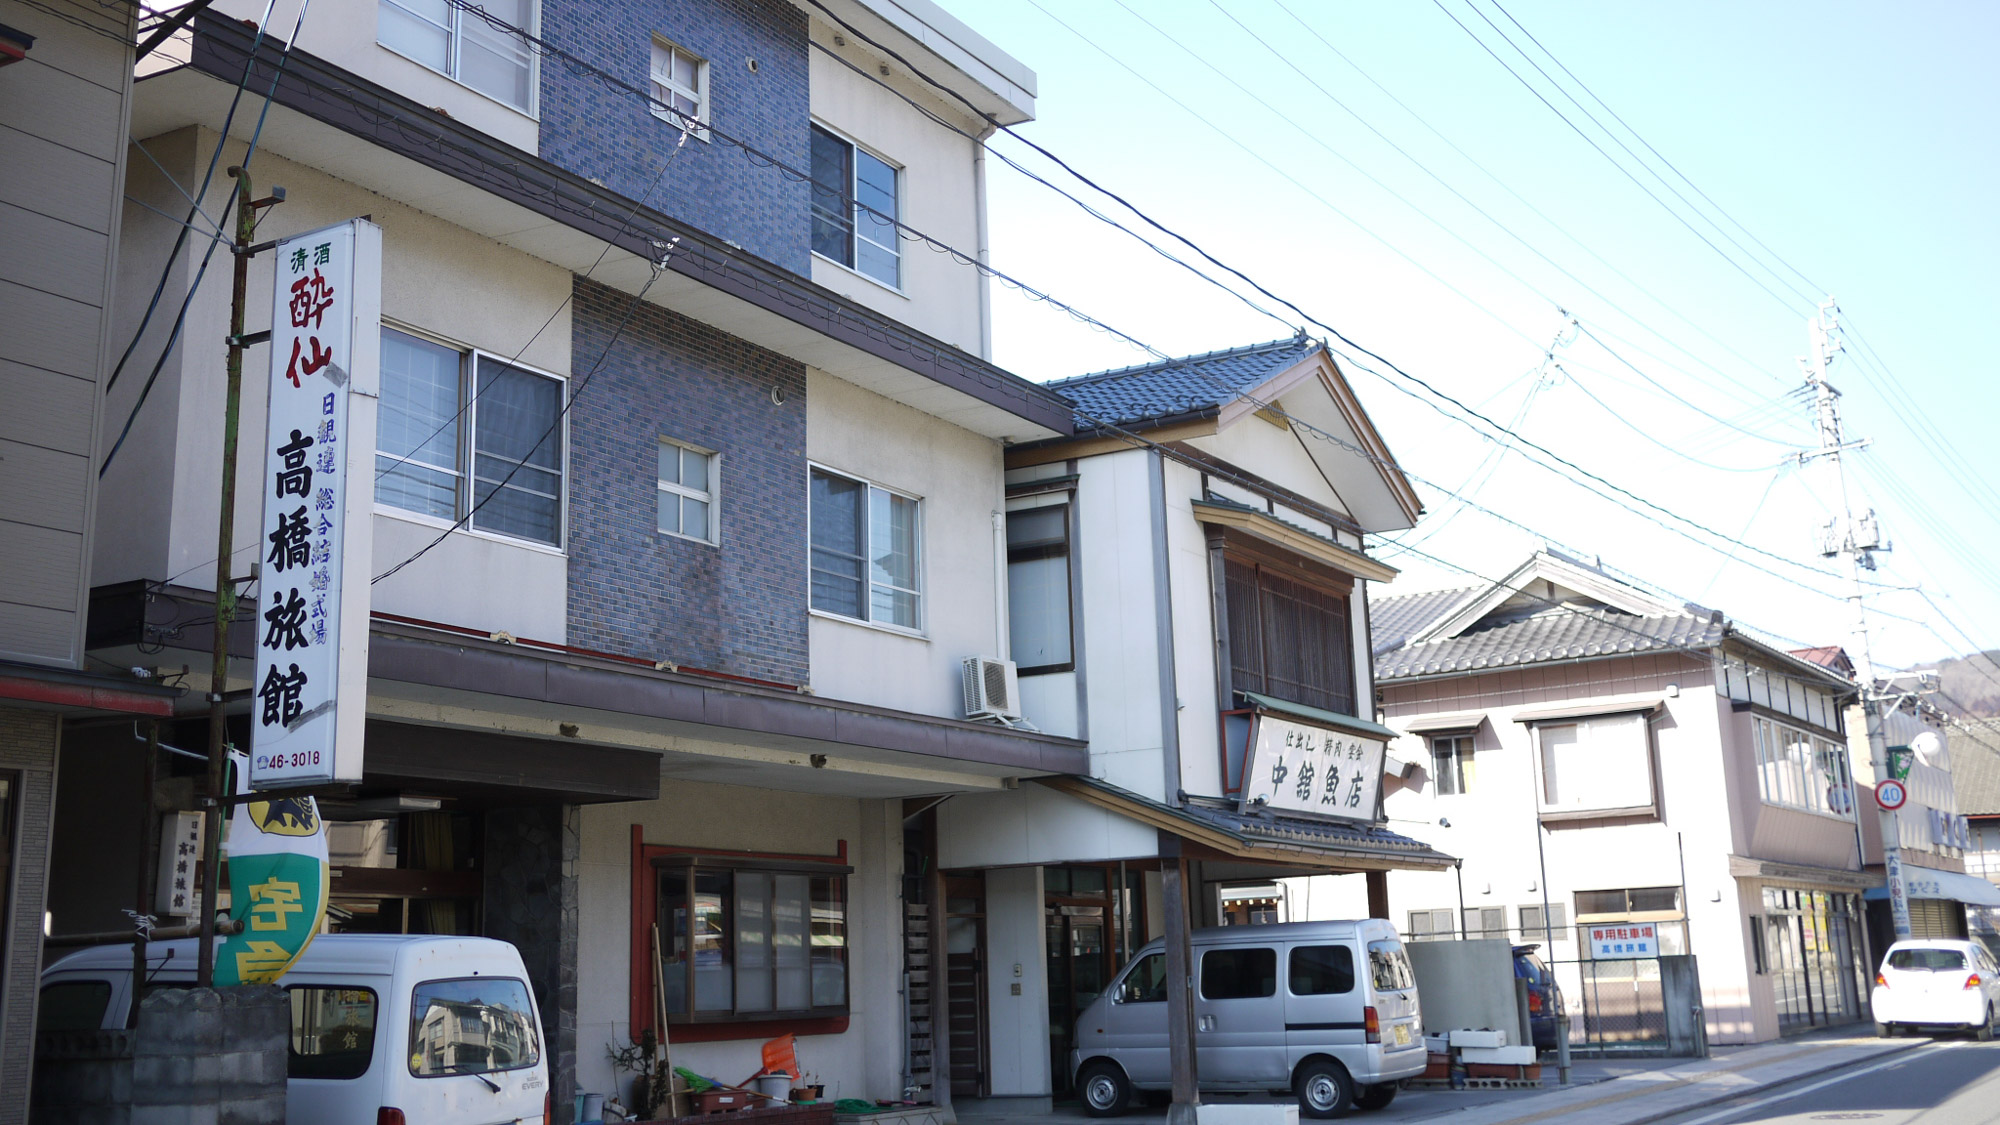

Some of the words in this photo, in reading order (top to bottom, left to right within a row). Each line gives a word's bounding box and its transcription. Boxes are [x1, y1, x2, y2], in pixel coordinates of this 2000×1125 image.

[290, 242, 332, 274] 清酒
[286, 267, 334, 388] 酔仙
[257, 428, 314, 728] 高橋旅館
[269, 751, 320, 770] 46-3018
[1882, 788, 1901, 802] 40
[1593, 926, 1653, 941] 専用駐車場
[522, 1080, 543, 1090] EVERY
